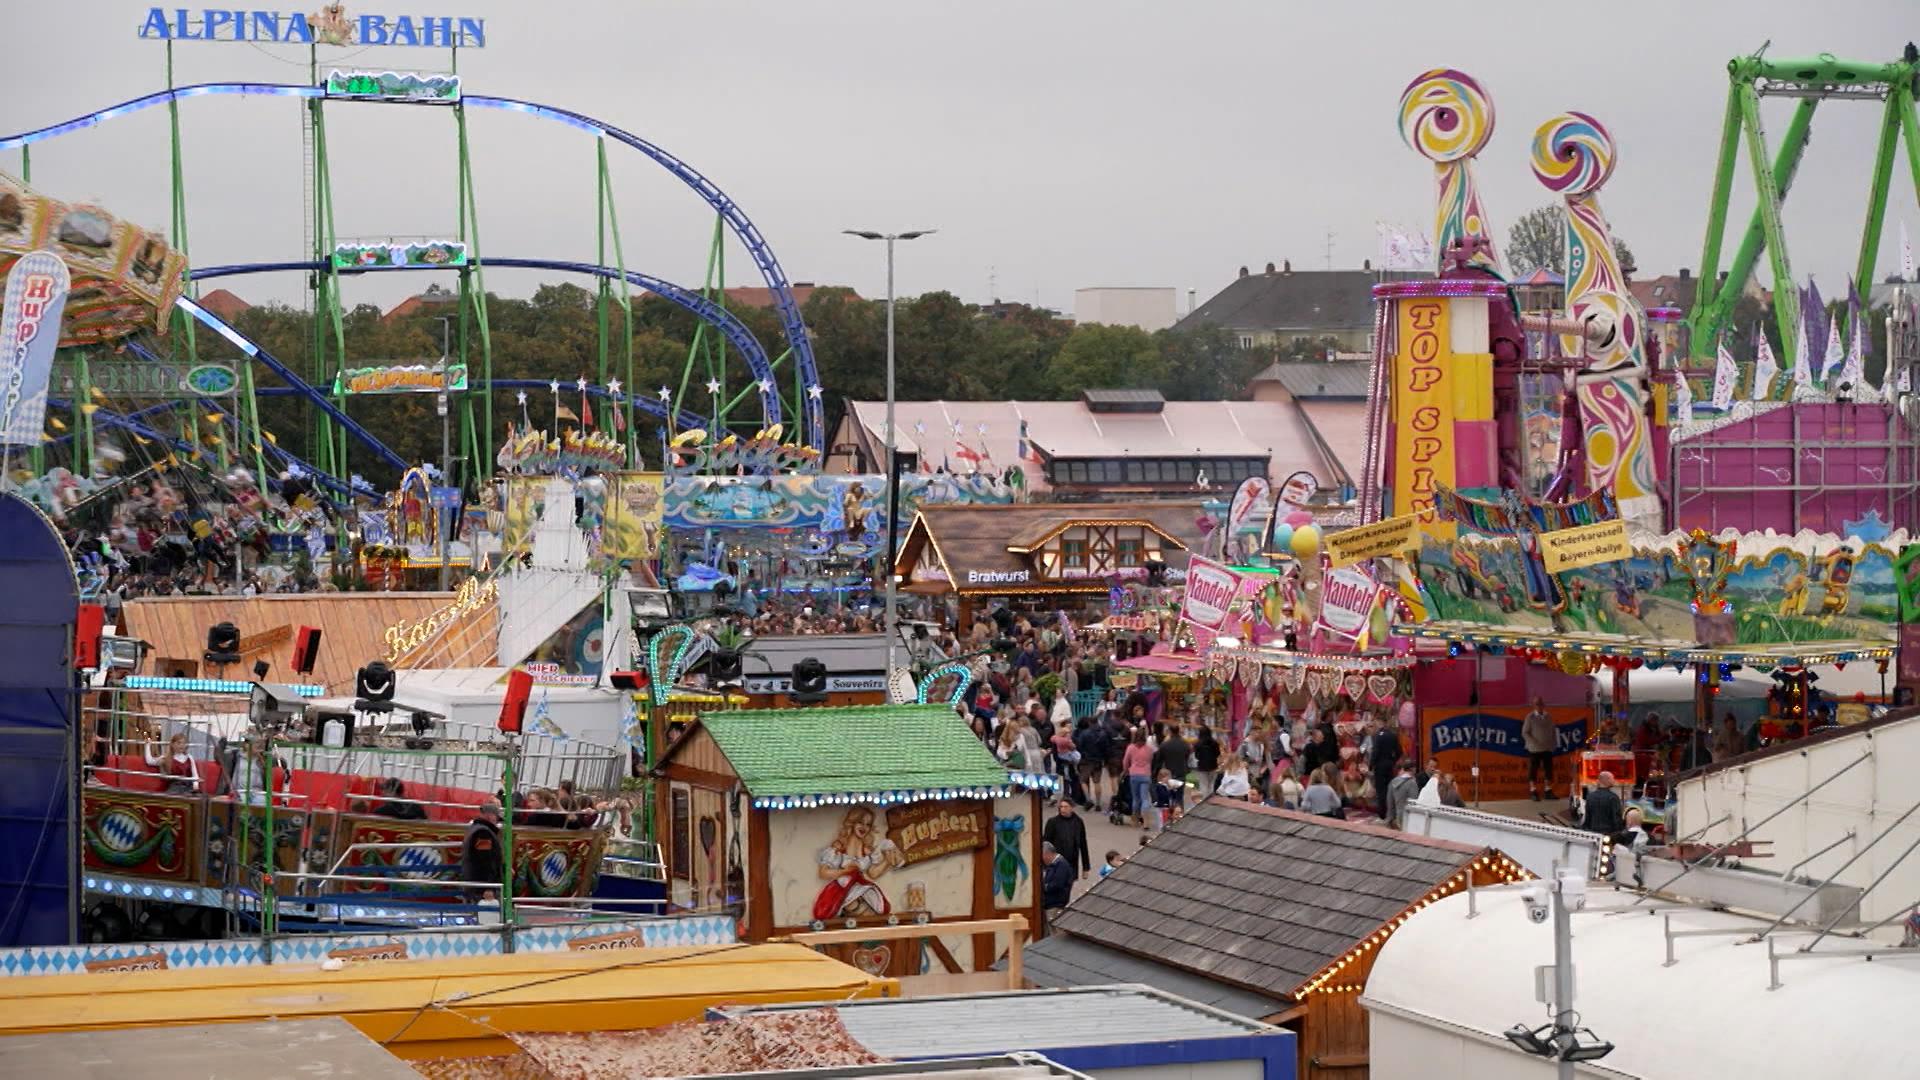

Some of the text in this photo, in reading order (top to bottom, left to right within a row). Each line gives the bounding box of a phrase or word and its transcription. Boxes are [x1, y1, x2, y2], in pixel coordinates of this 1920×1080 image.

[138, 7, 486, 47] ALPINA BAHN
[1409, 303, 1442, 392] TOP
[1550, 524, 1624, 548] Kinderkarussell
[1560, 543, 1623, 562] Bayern-Rallye
[967, 569, 1030, 583] Bratwurst
[832, 679, 884, 689] Souvenirs
[1434, 724, 1508, 748] Bayern
[901, 810, 979, 850] Hupferl
